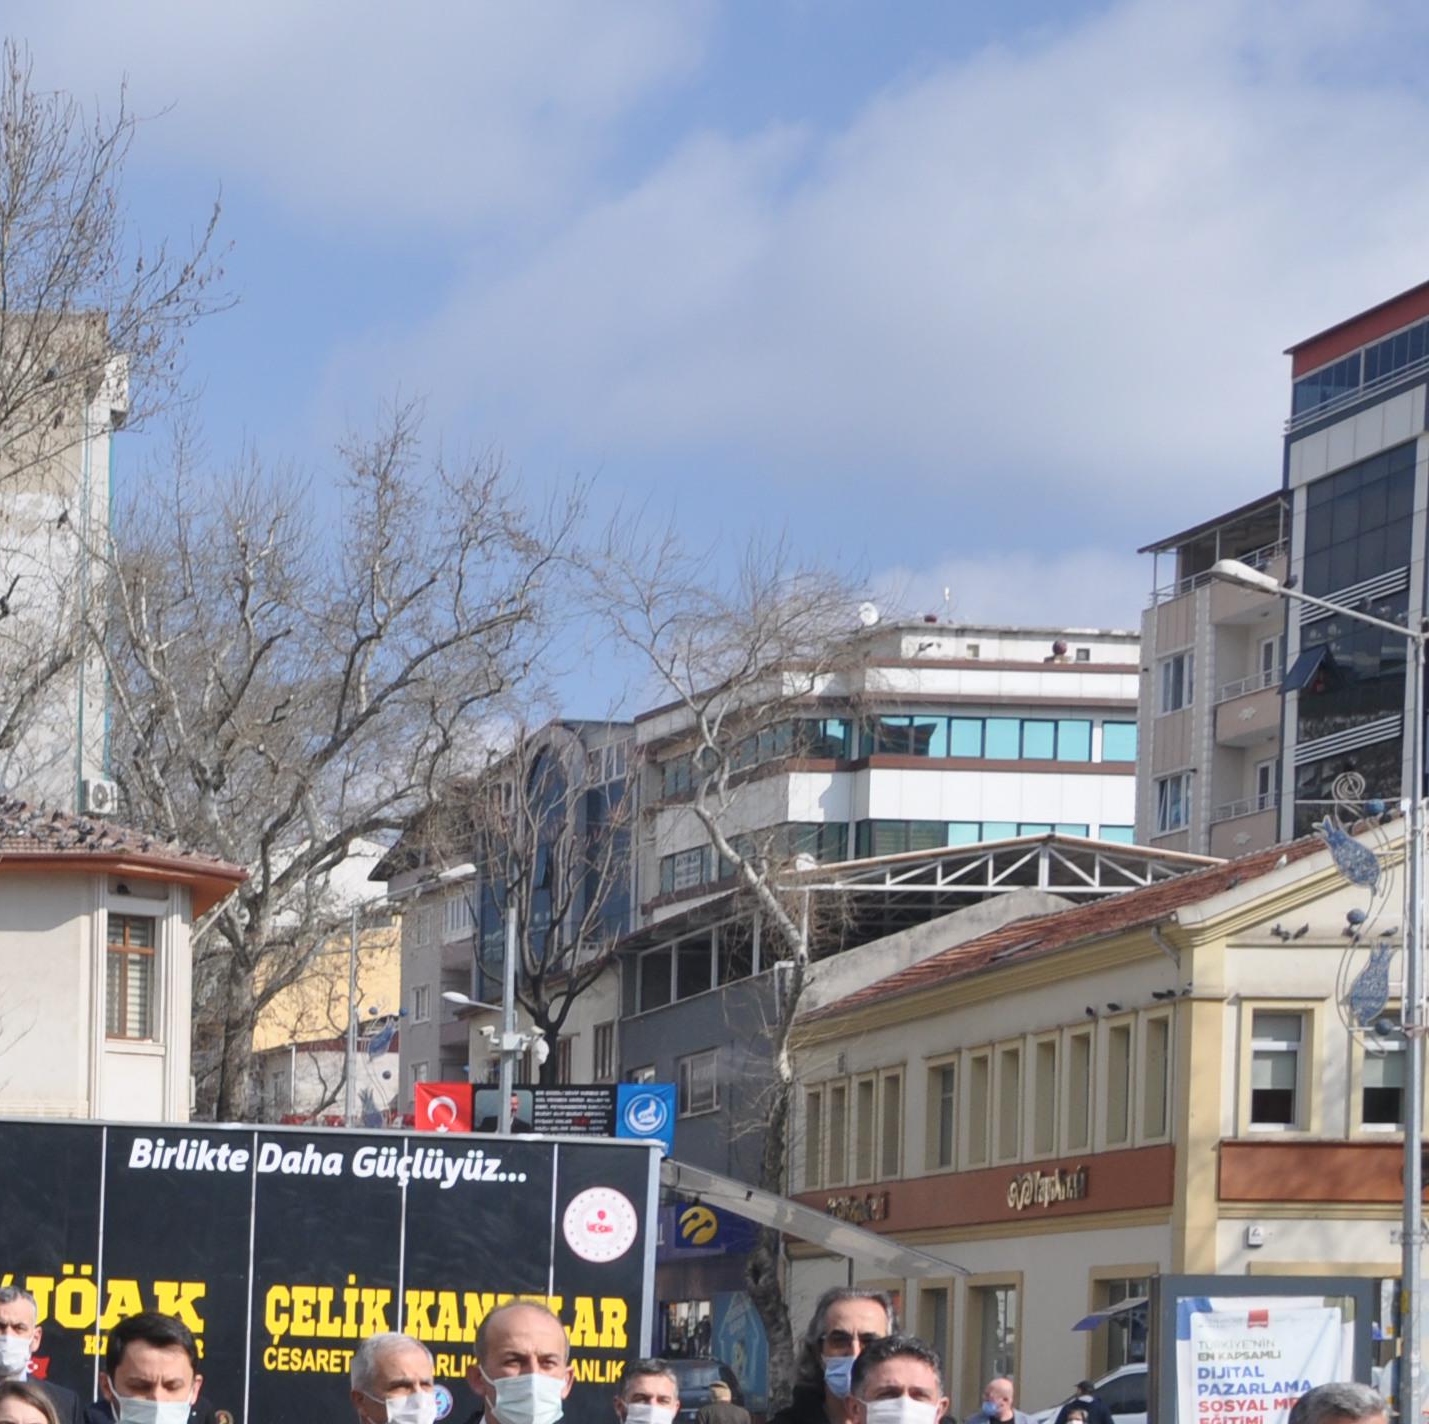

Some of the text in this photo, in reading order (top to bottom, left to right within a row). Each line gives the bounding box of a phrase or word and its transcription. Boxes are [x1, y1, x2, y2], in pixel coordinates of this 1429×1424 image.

[128, 1138, 528, 1189] Birlikte Daha Güçlüyüz...
[264, 1273, 392, 1345] ÇELİK
[1198, 1366, 1265, 1379] DİJİTAL
[1198, 1380, 1312, 1396] PAZARLAMA
[1199, 1399, 1269, 1413] SOSYAL
